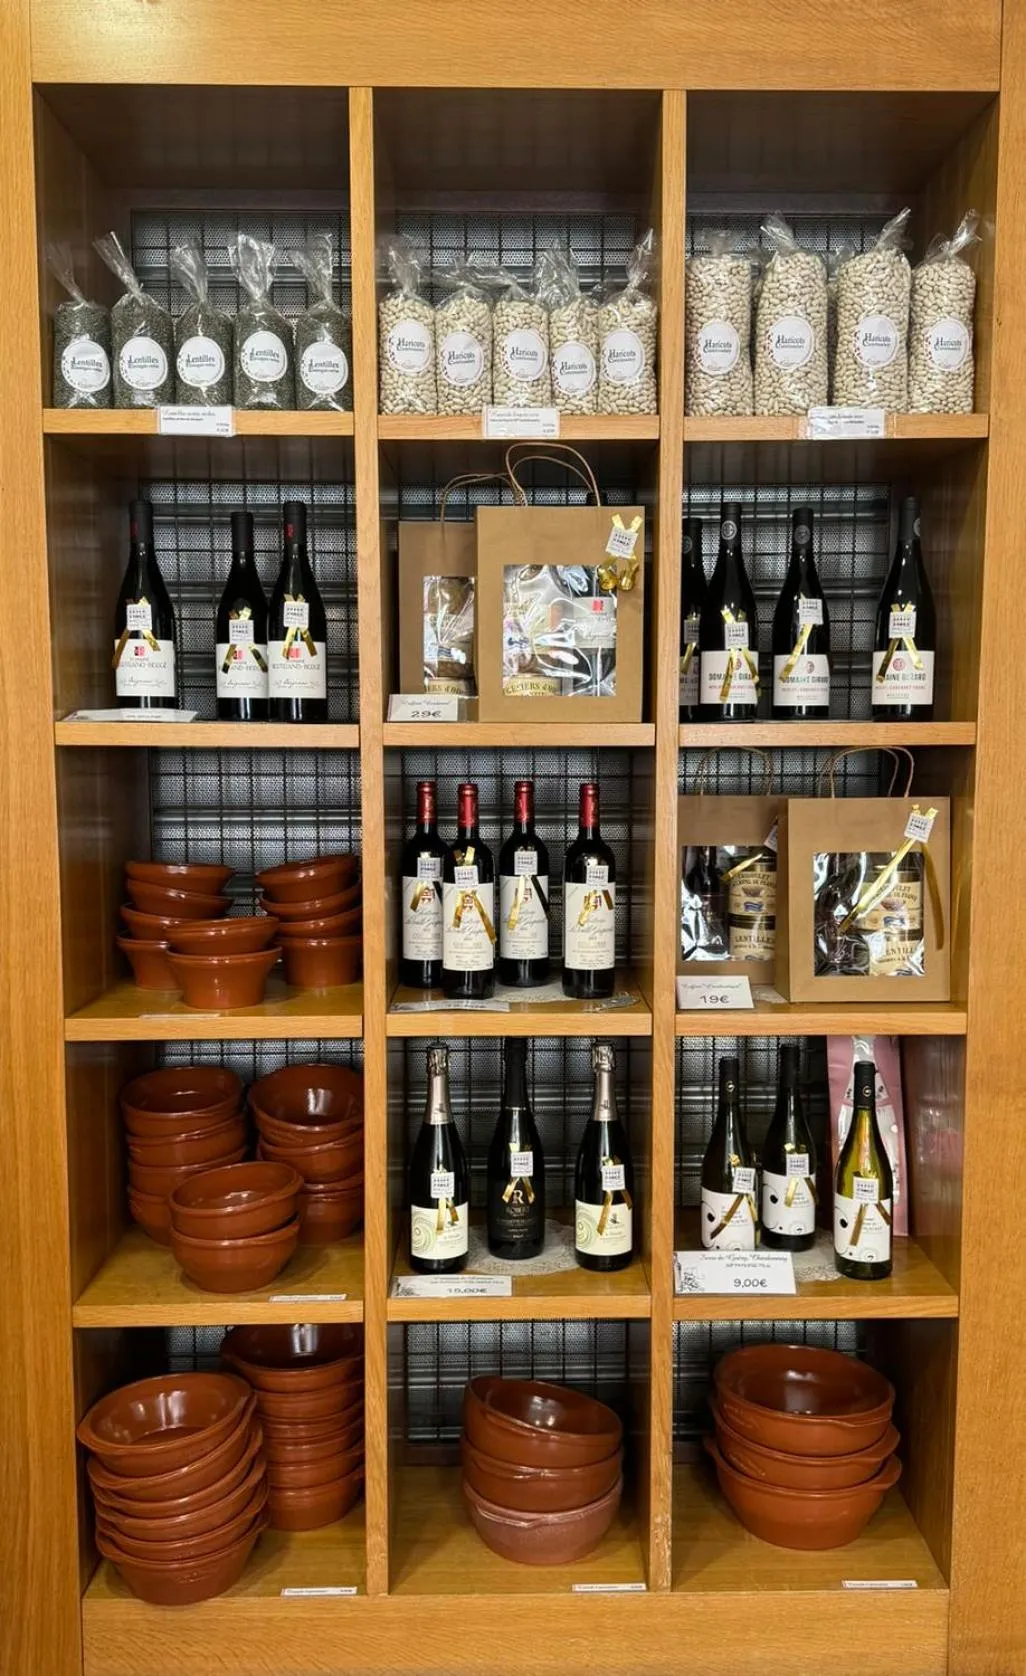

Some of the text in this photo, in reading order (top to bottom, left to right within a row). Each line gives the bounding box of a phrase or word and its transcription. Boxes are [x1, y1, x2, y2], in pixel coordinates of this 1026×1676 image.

[704, 339, 732, 348] Haricots
[250, 347, 280, 358] Lentilles
[128, 355, 159, 364] Lentilles
[186, 354, 215, 363] Lentilles
[309, 359, 339, 369] Lentilles
[411, 710, 442, 718] 29€
[699, 994, 730, 1004] 19€
[733, 1278, 768, 1288] 9,00€
